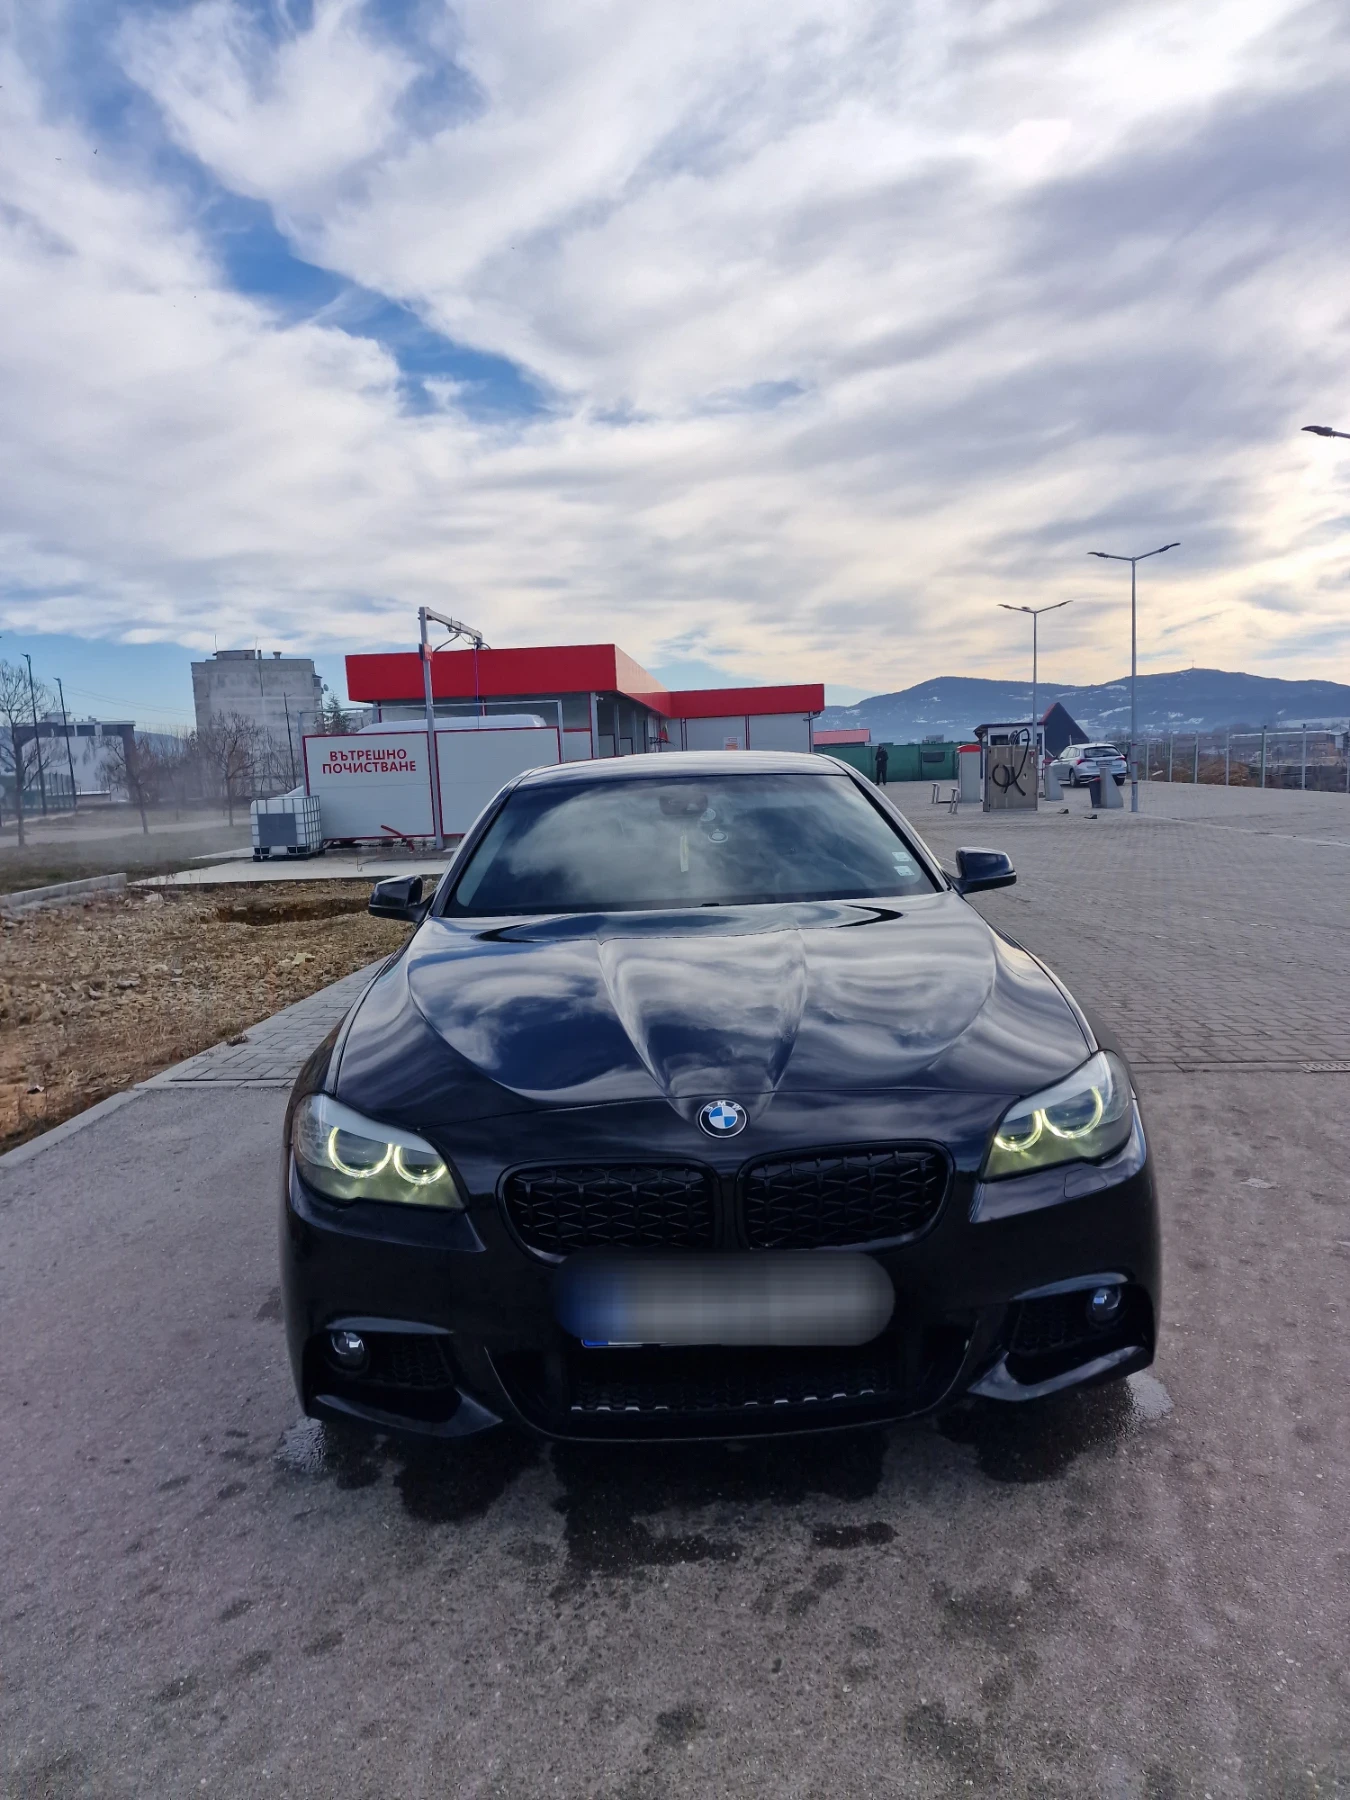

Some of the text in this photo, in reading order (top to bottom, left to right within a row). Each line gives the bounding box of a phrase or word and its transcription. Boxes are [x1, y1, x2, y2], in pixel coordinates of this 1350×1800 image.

[329, 749, 407, 761] ВЪТРЕШНО
[322, 761, 417, 774] ПОЧИСТВАНЕ
[704, 1101, 742, 1112] BMW
